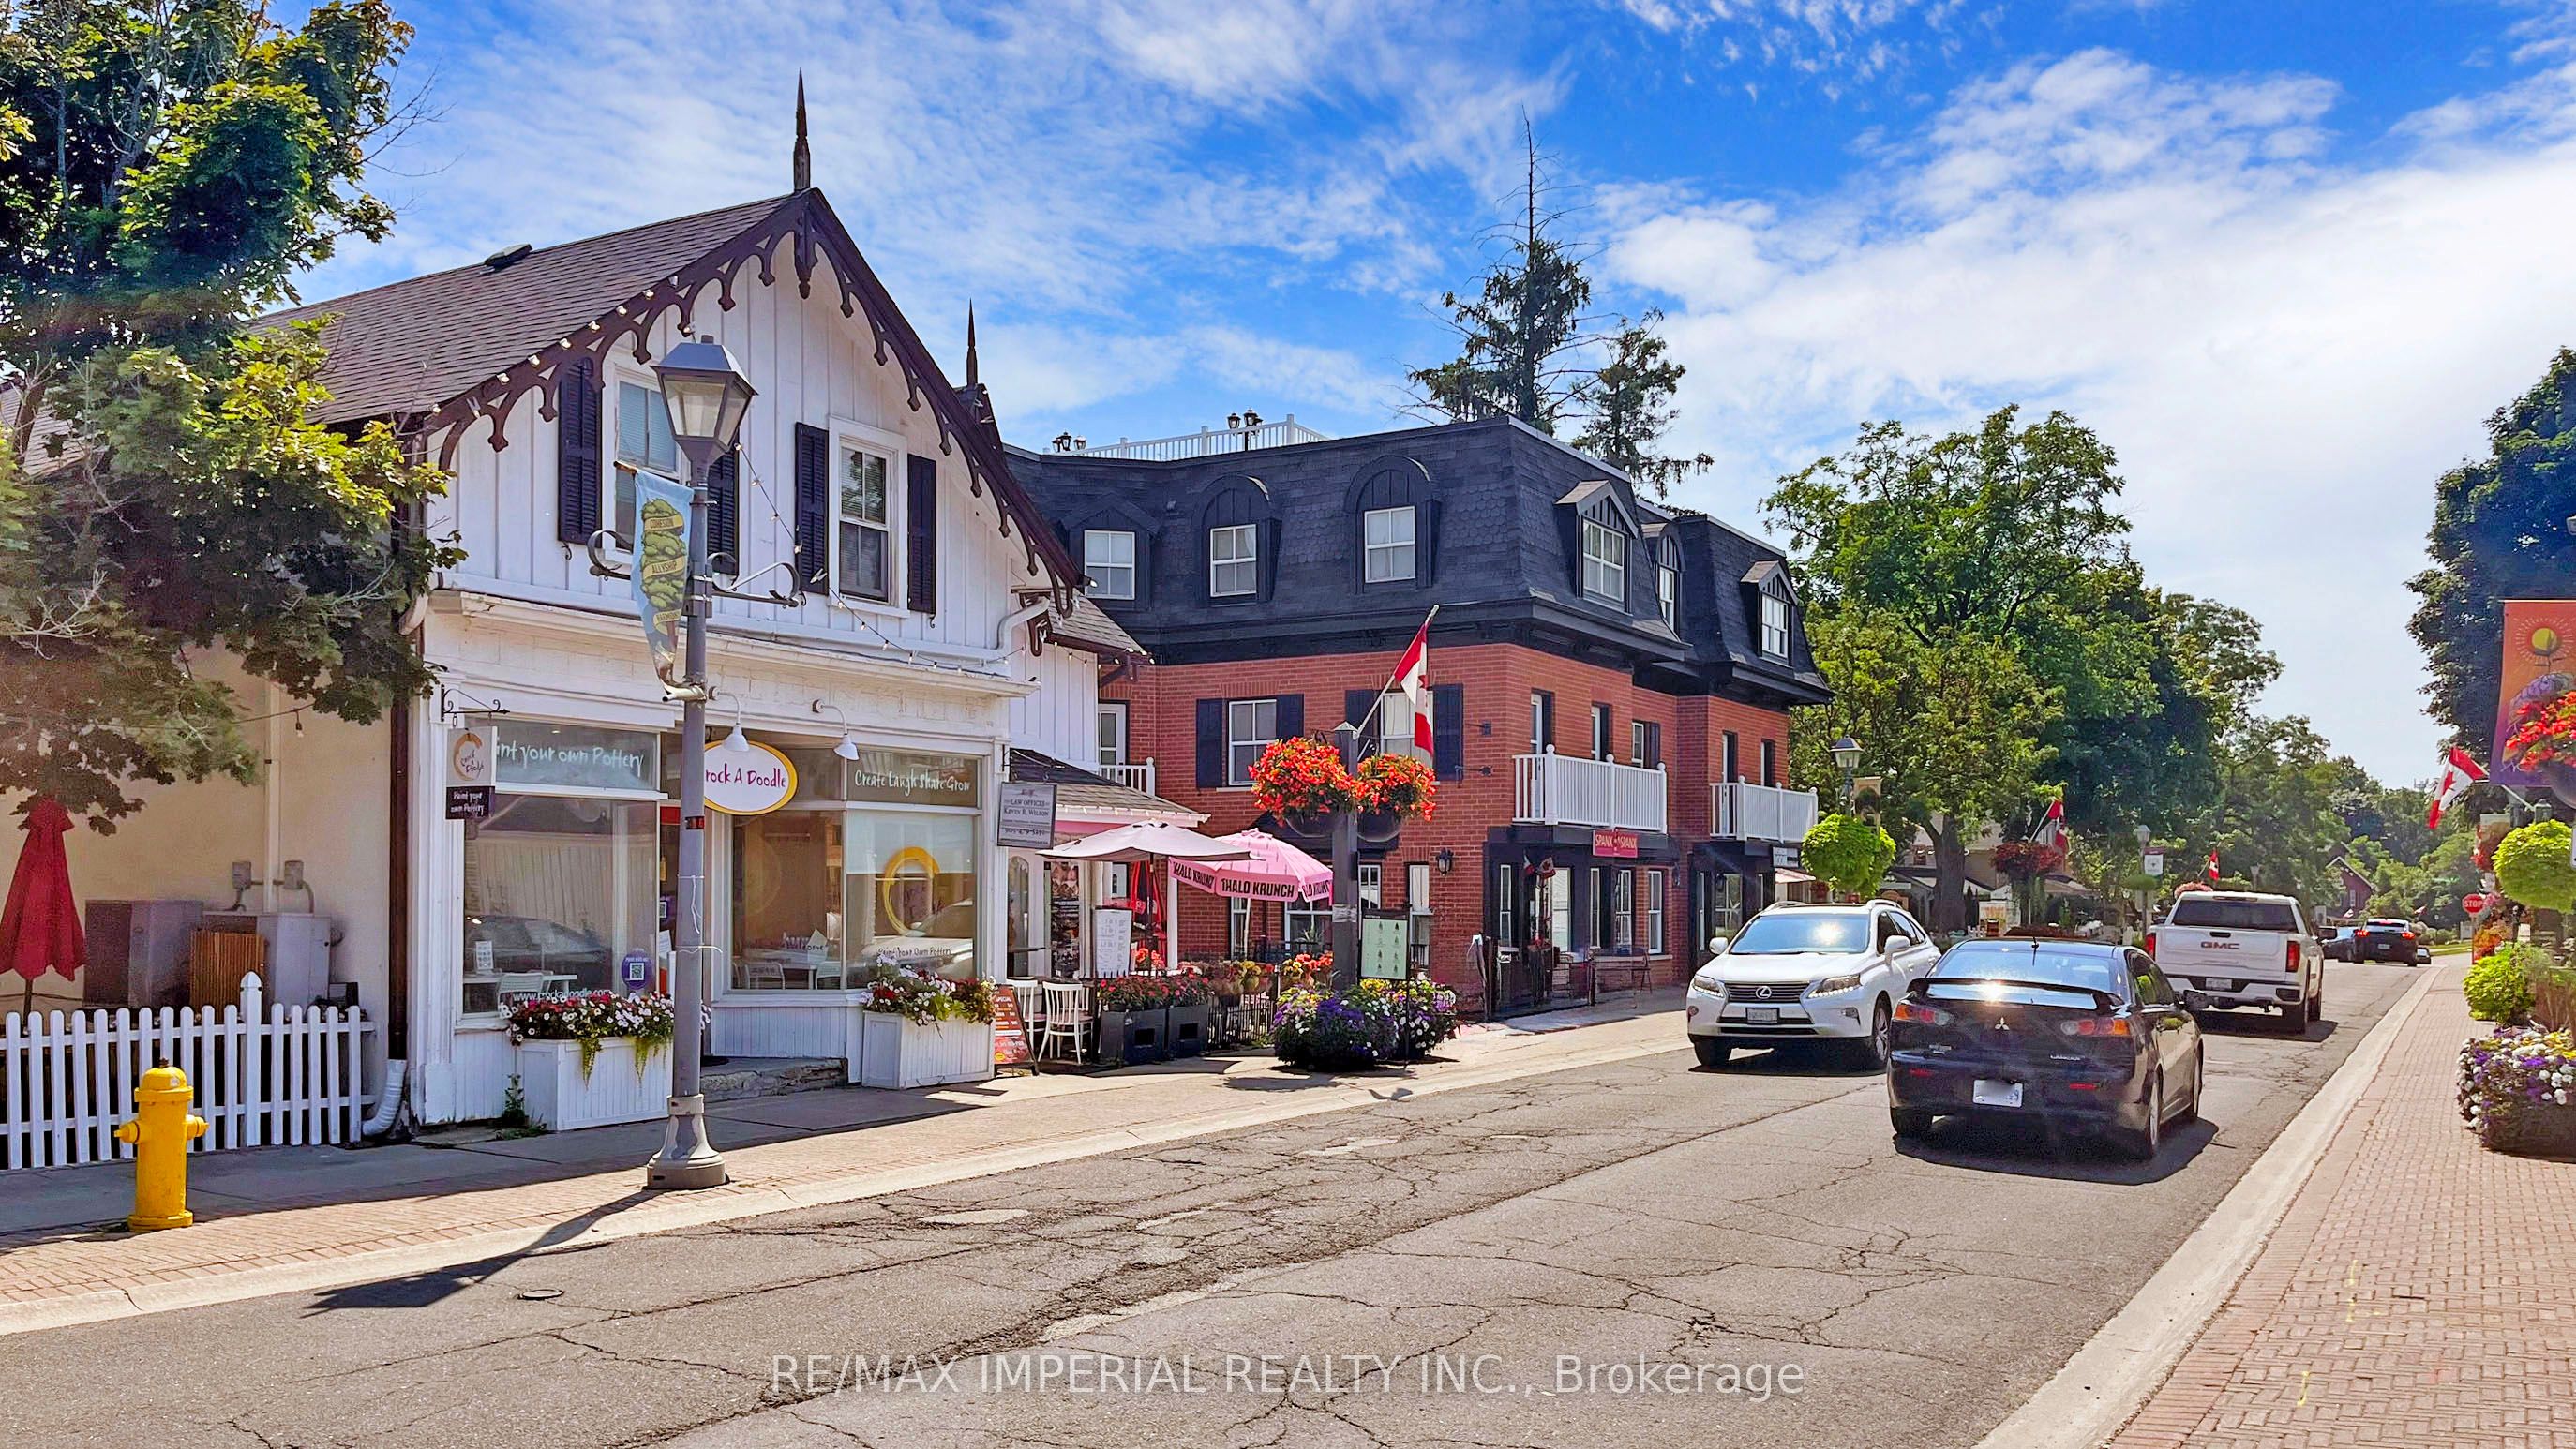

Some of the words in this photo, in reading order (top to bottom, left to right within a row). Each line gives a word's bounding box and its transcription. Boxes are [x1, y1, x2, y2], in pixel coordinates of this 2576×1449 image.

[520, 744, 556, 769] your
[558, 750, 589, 763] own
[592, 746, 645, 778] Pottery
[705, 762, 731, 784] rock
[734, 767, 743, 784] A
[747, 767, 786, 787] Doodle
[855, 769, 885, 787] Create
[889, 768, 917, 796] Laugh
[946, 776, 971, 792] Grow
[1252, 881, 1295, 898] KRUNCH
[2464, 900, 2483, 908] STOP
[2200, 941, 2239, 949] GMC
